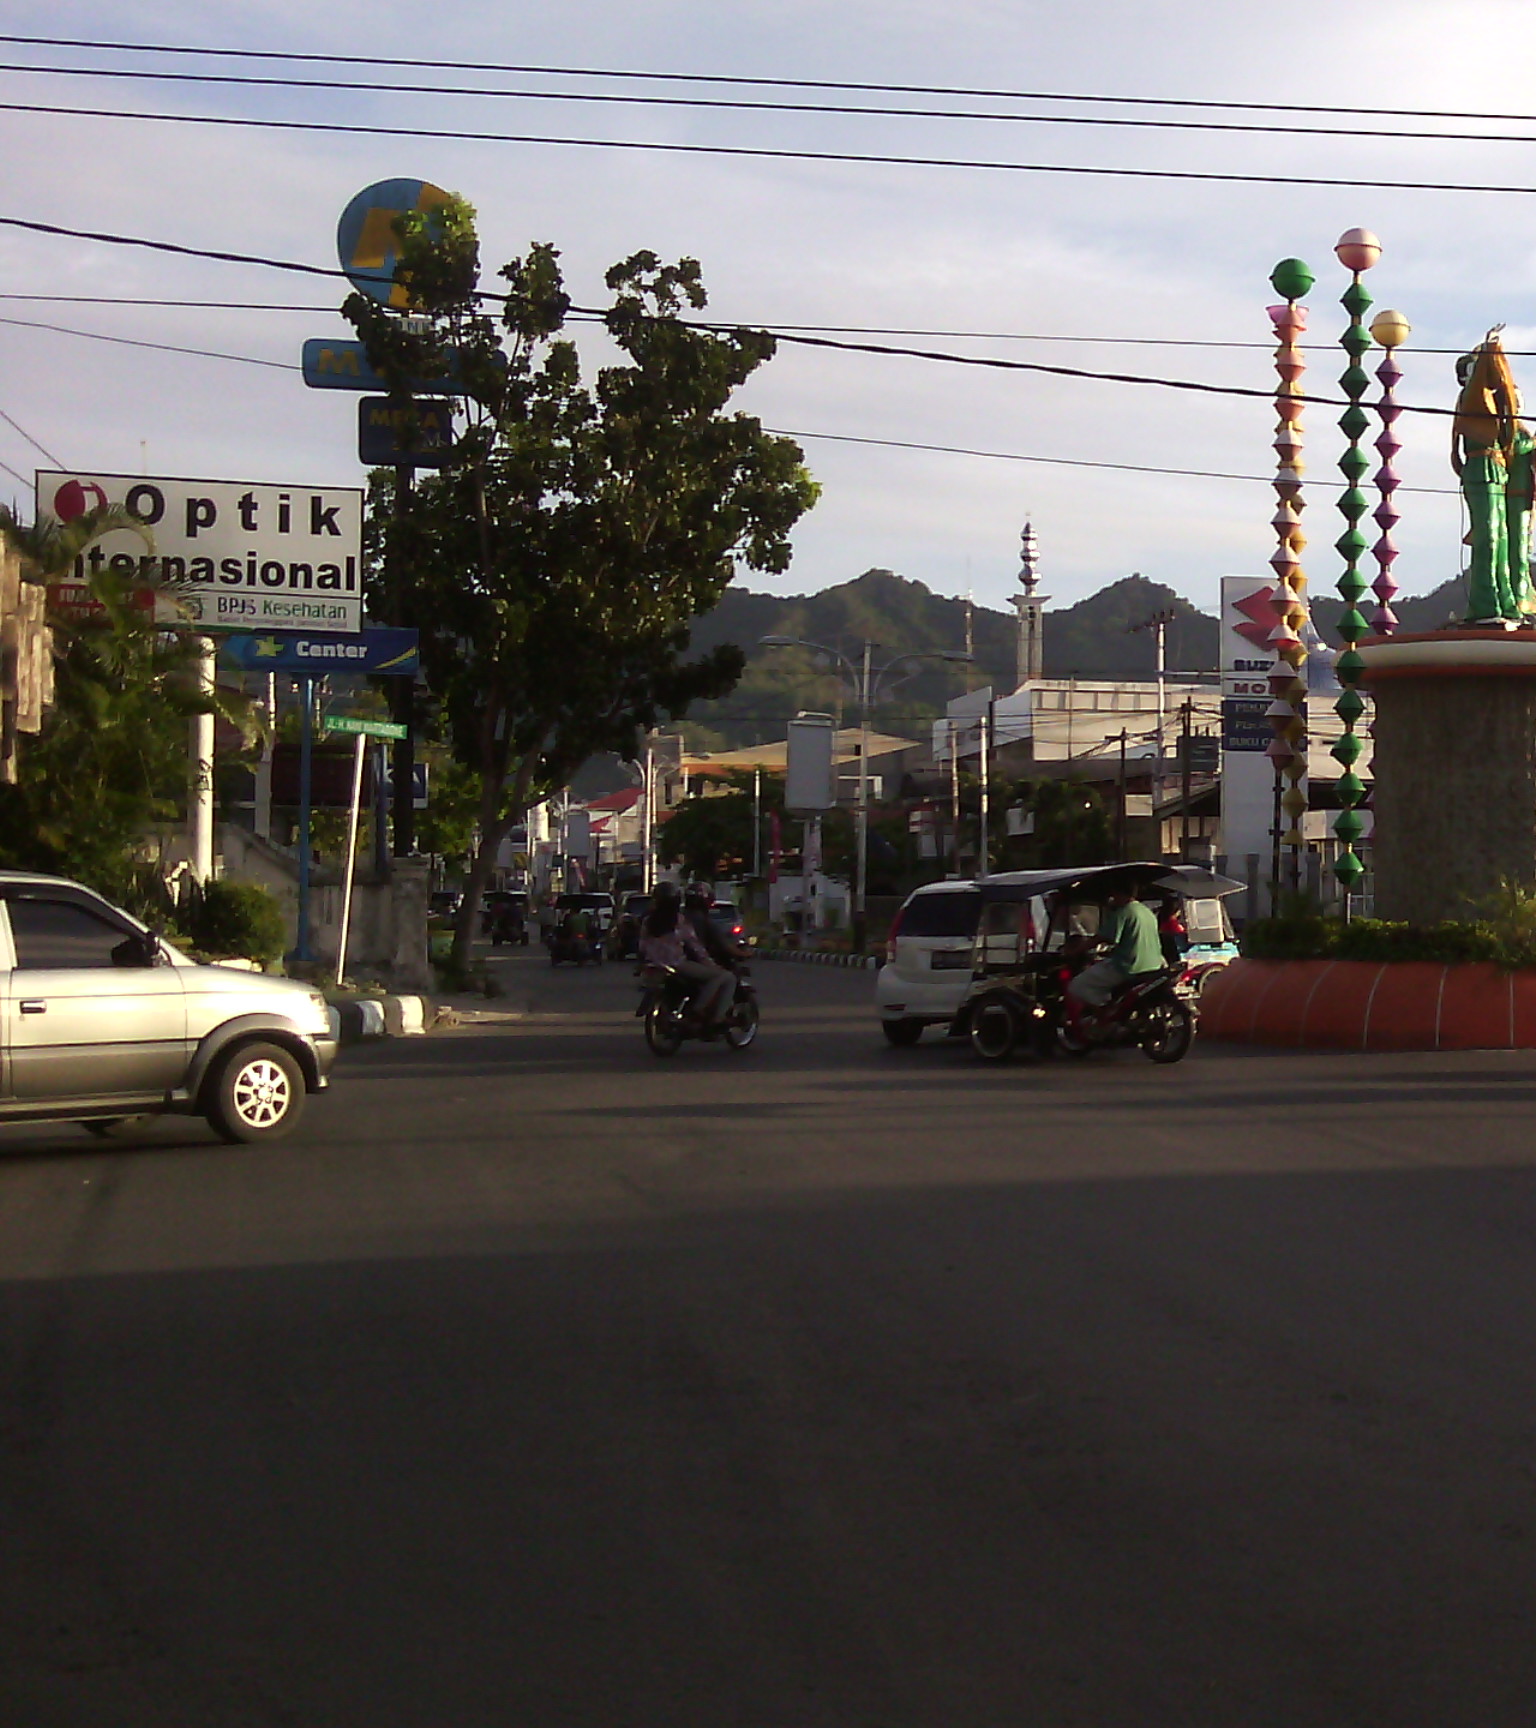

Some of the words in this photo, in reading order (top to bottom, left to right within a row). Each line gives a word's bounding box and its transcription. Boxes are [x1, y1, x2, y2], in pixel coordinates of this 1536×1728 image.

[125, 484, 342, 537] Optik
[67, 546, 356, 591] nternasional
[218, 596, 257, 615] BPJS
[263, 600, 347, 619] Kesehatan
[296, 641, 368, 658] Center
